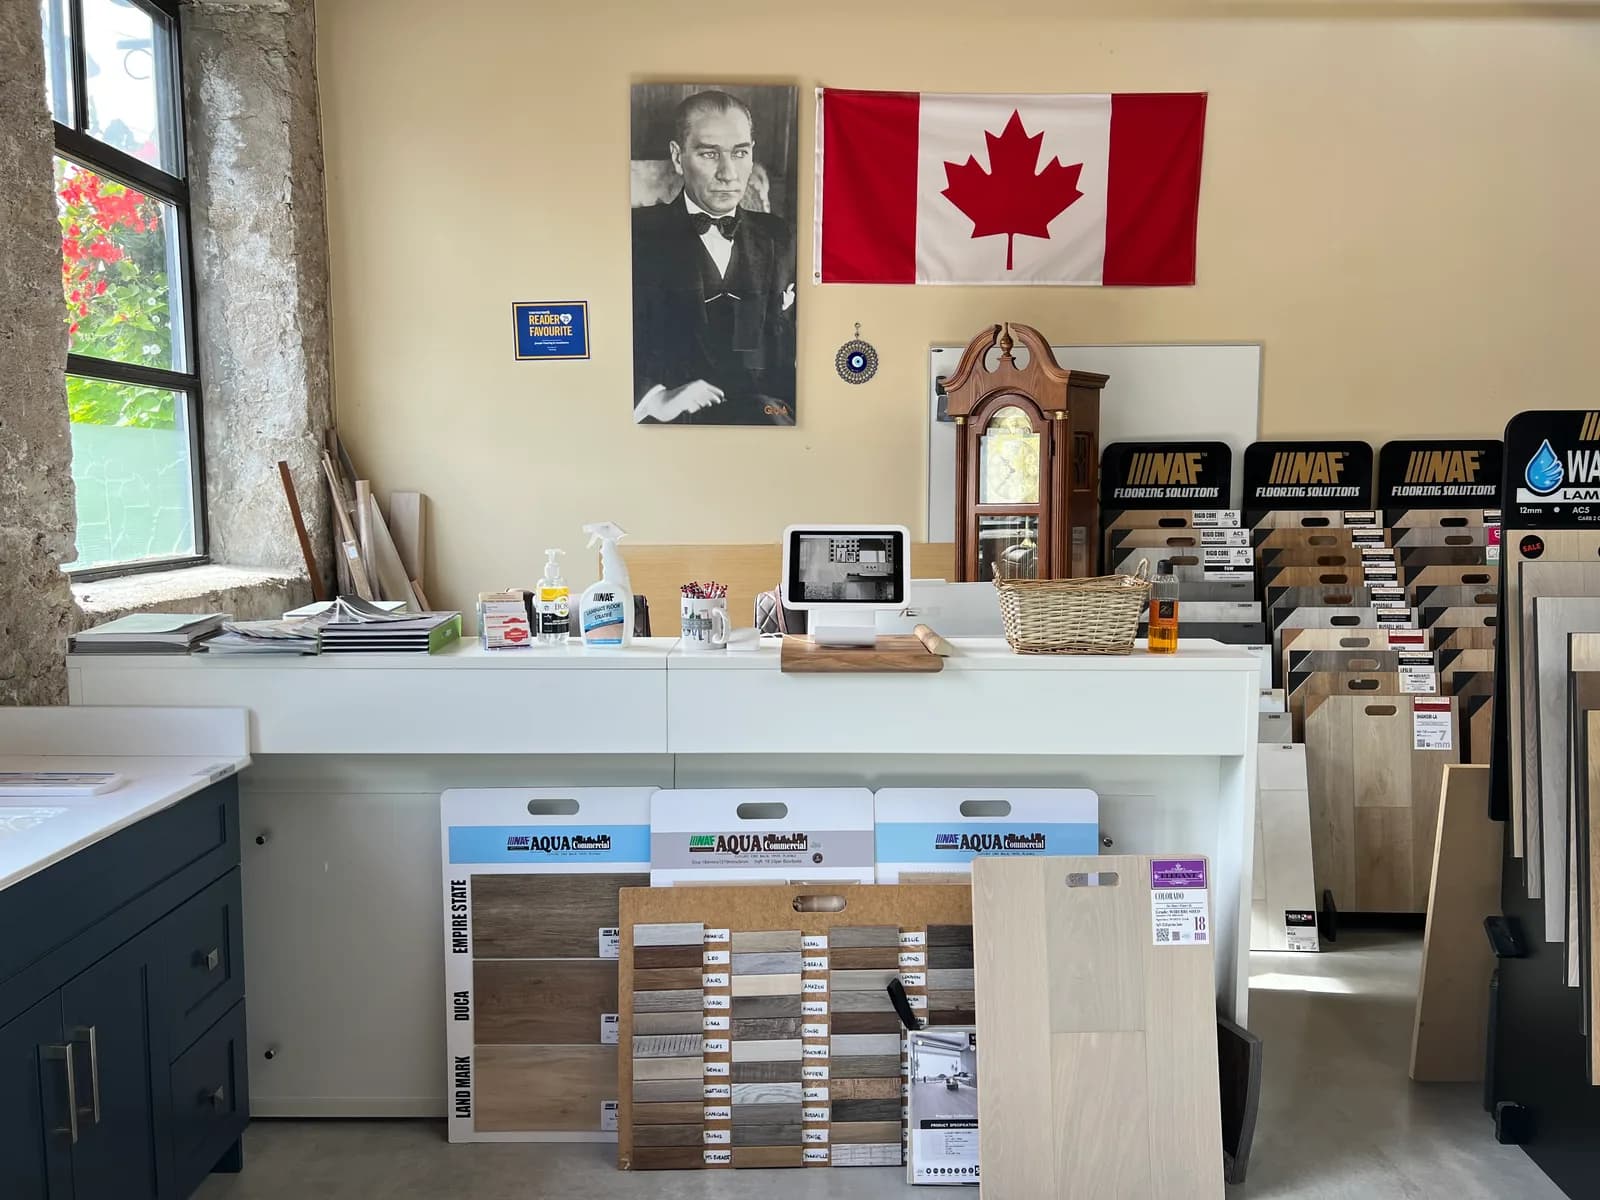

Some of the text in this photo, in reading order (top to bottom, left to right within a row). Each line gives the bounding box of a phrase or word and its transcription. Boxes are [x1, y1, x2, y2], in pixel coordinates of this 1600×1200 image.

[528, 315, 560, 325] READER
[529, 326, 573, 337] FAVOURITE
[1113, 487, 1219, 499] FLOORING SOLUTIONS
[1255, 486, 1361, 498] FLOORING SOLUTIONS
[1391, 485, 1497, 497] FLOORING SOLUTIONS
[1519, 506, 1590, 514] 12mm AC5
[1521, 543, 1542, 553] SALE
[530, 836, 571, 853] AQUA
[572, 840, 611, 849] Commercial
[716, 834, 762, 854] AQUA
[764, 839, 807, 850] Commercial
[960, 833, 1003, 852] AQUA
[1004, 839, 1045, 849] Commercial
[1154, 891, 1185, 901] COLORADO
[451, 879, 469, 954] EMPIRE STATE
[1194, 915, 1206, 931] 18
[453, 990, 470, 1021] DUCA
[455, 1055, 471, 1119] LAND MARK
